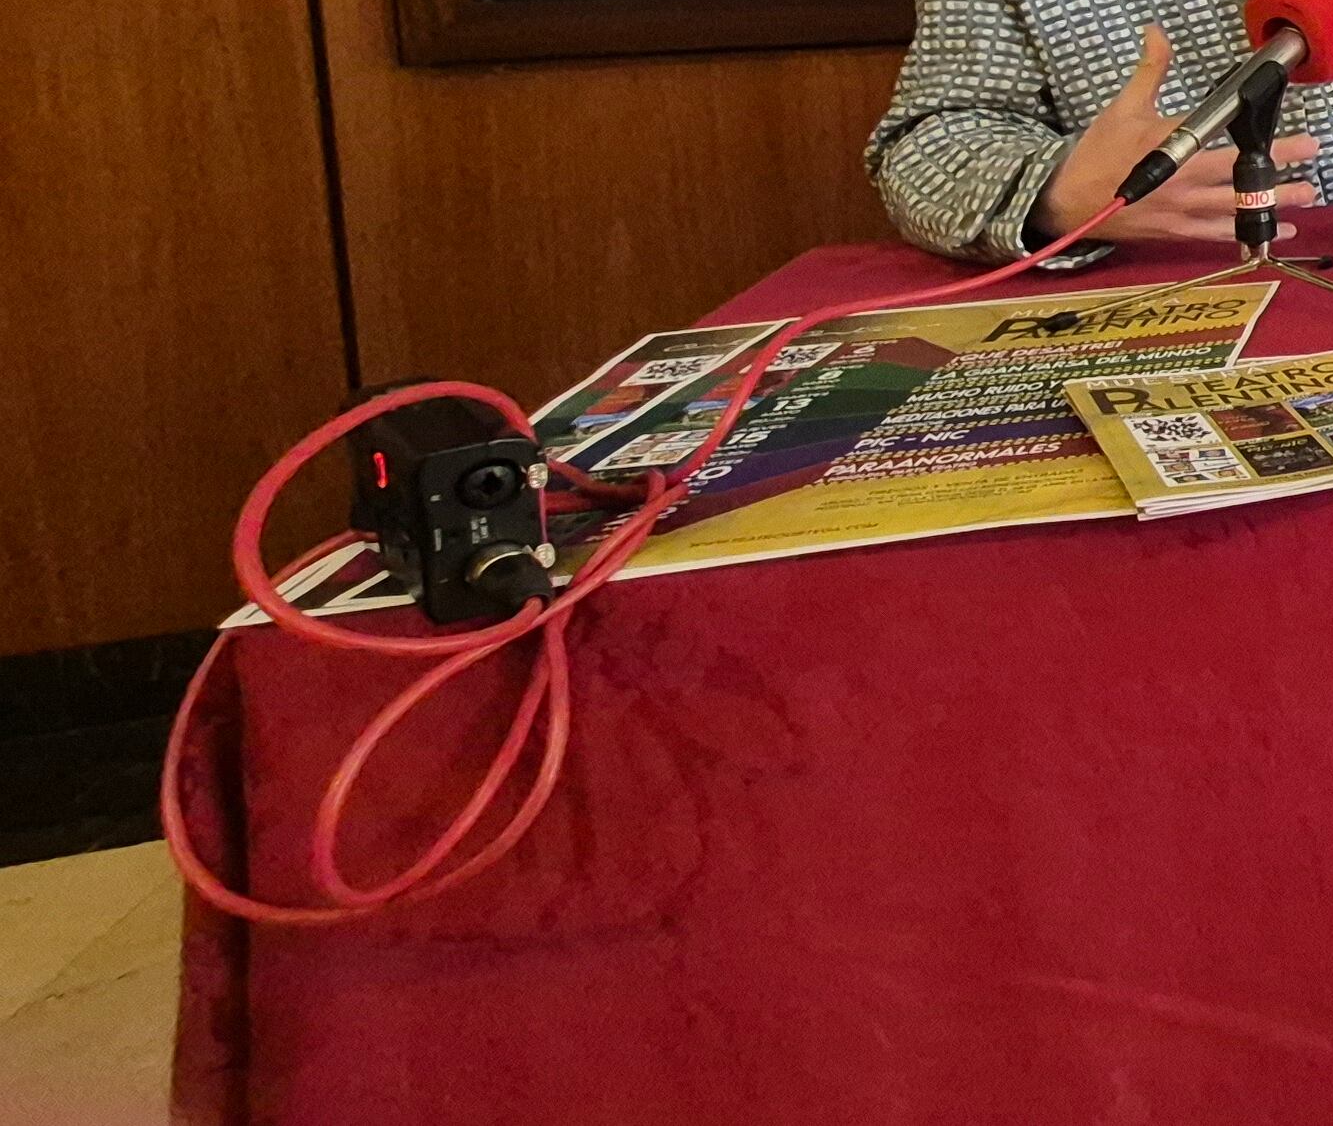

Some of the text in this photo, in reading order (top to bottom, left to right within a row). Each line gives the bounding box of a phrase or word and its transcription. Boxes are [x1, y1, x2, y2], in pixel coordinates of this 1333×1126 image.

[964, 346, 1212, 377] GRAN DEL MUNDO
[906, 381, 1044, 403] MUCHO RUIDO
[1004, 400, 1047, 413] PARA
[854, 429, 970, 449] PIC NIC
[823, 441, 1063, 477] PARAANORMALES
